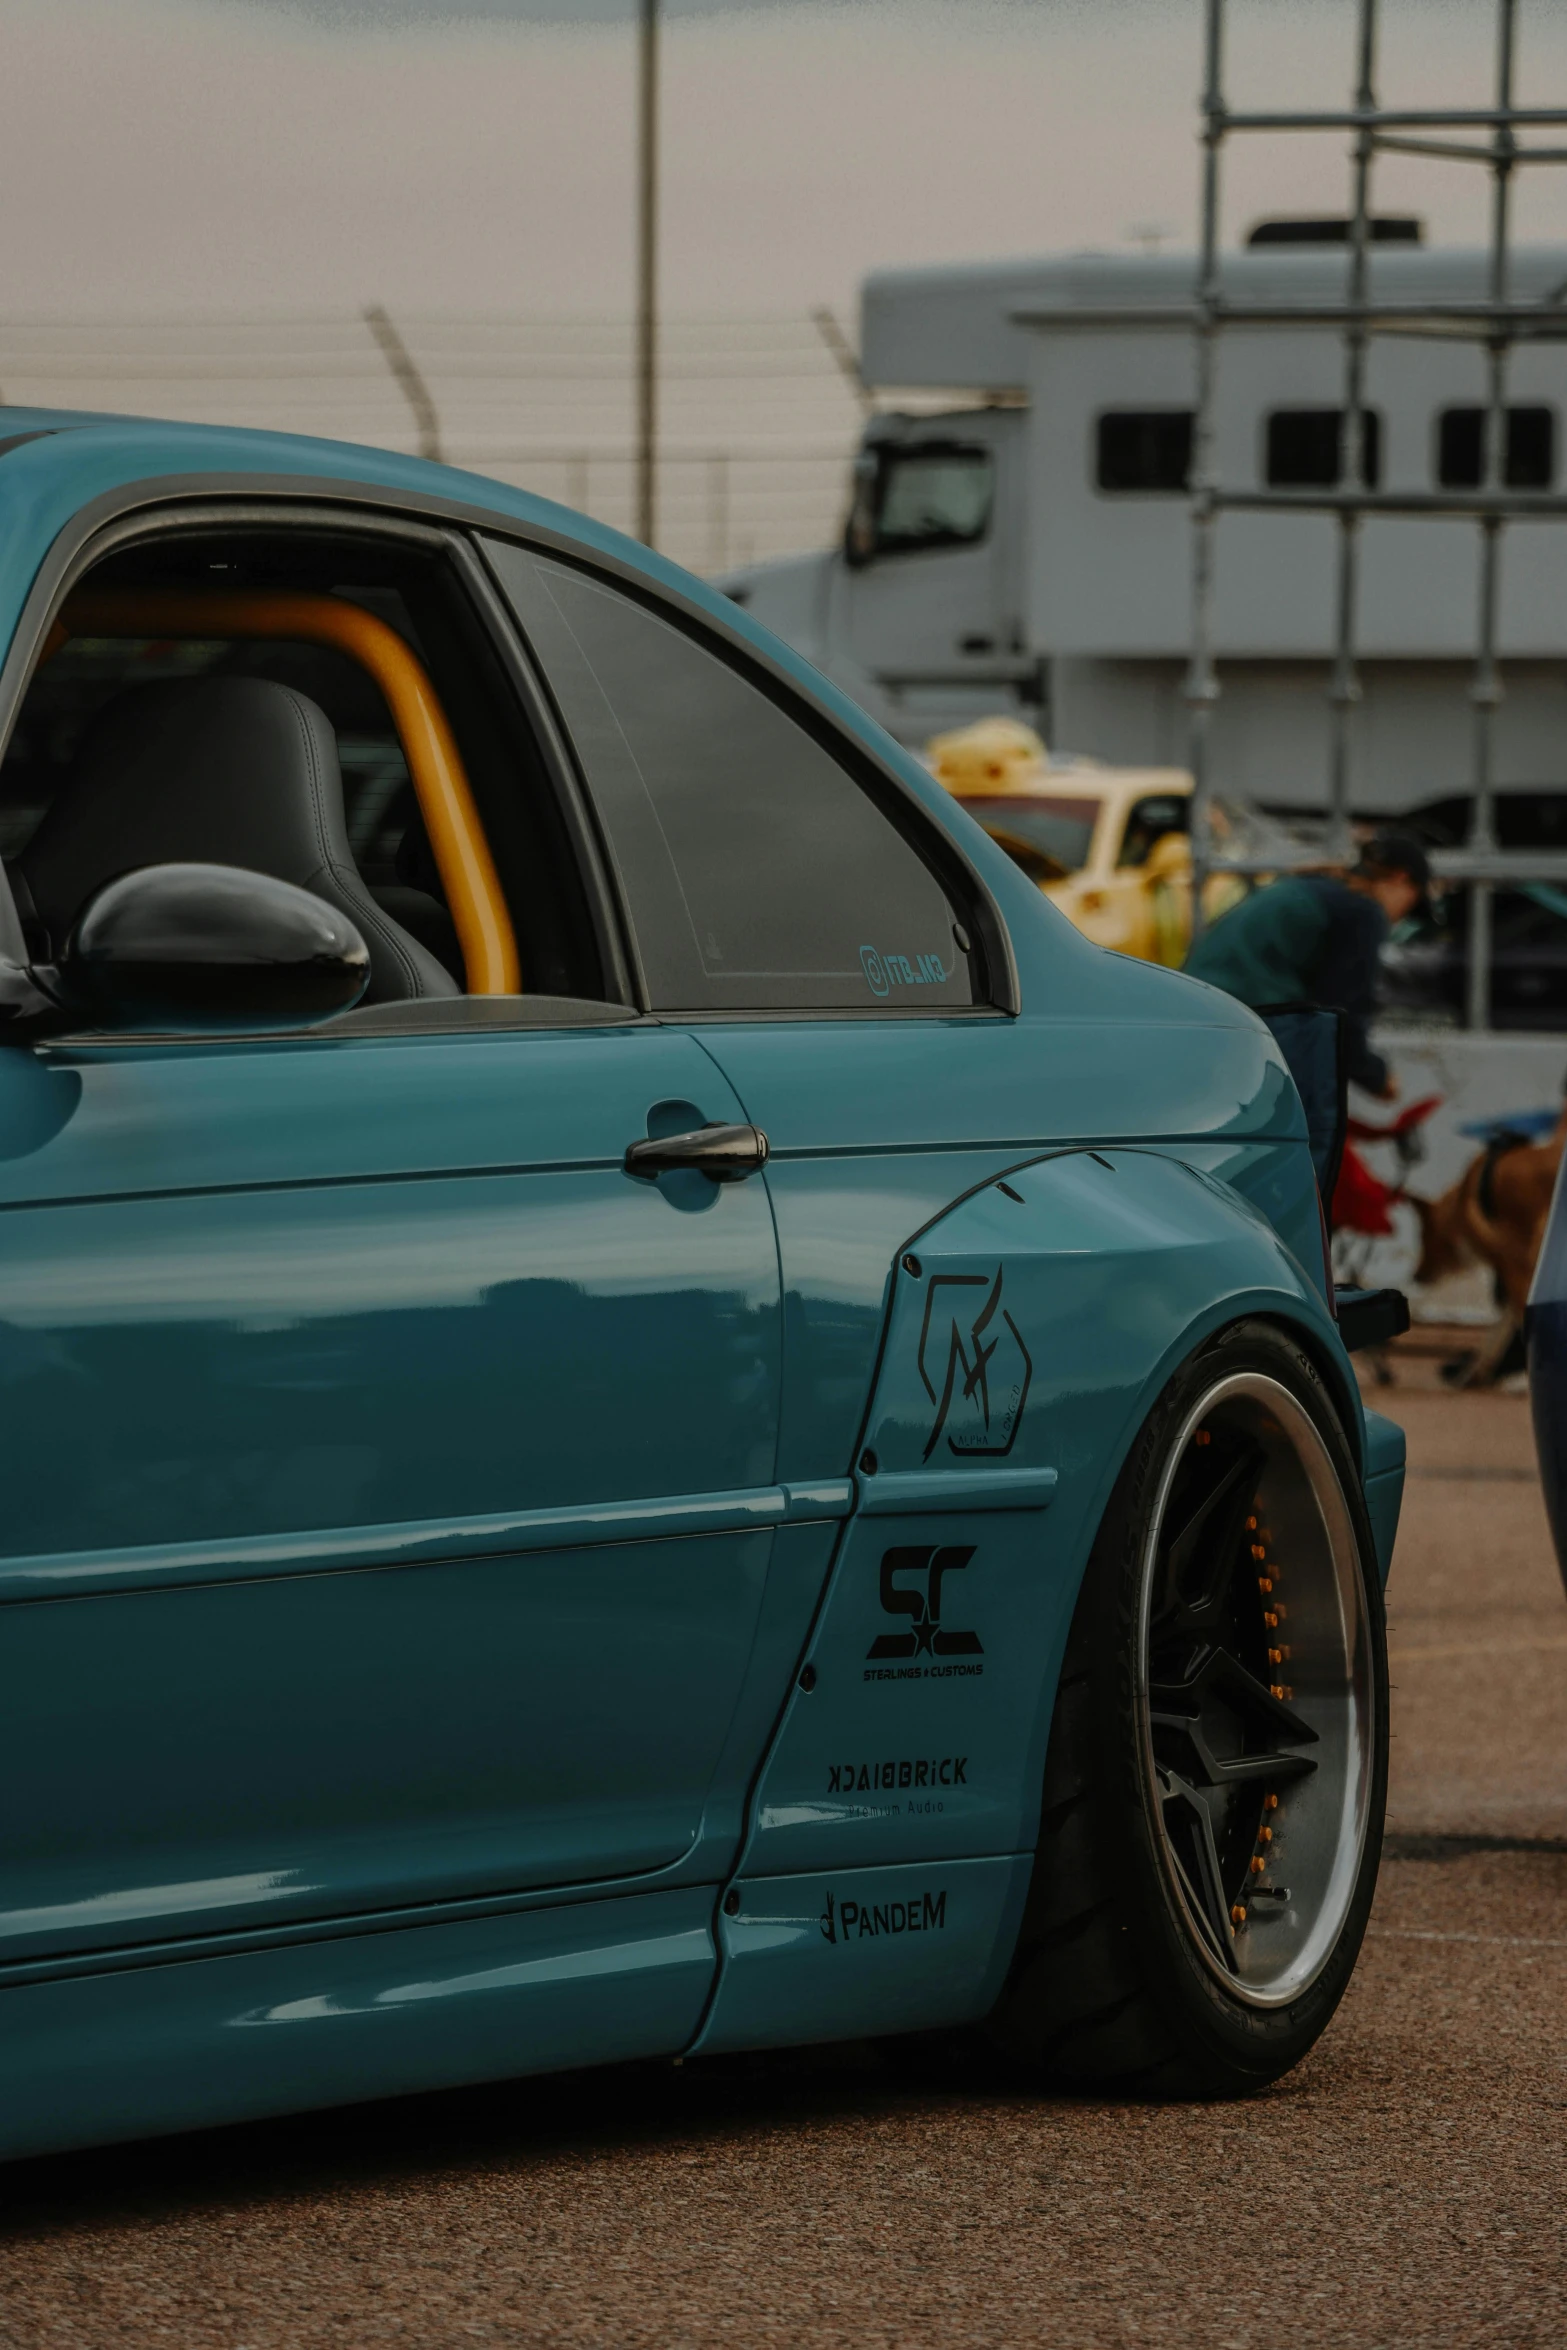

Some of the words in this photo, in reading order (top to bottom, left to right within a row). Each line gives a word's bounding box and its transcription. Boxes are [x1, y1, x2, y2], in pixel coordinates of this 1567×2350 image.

[882, 953, 947, 985] ITB_M3
[958, 1435, 989, 1447] ALPHA
[863, 1667, 922, 1681] STERLINGS
[930, 1664, 984, 1677] CUSTOMS
[848, 1804, 901, 1819] Premium
[907, 1800, 944, 1815] Audio
[840, 1891, 948, 1941] PANDEM
